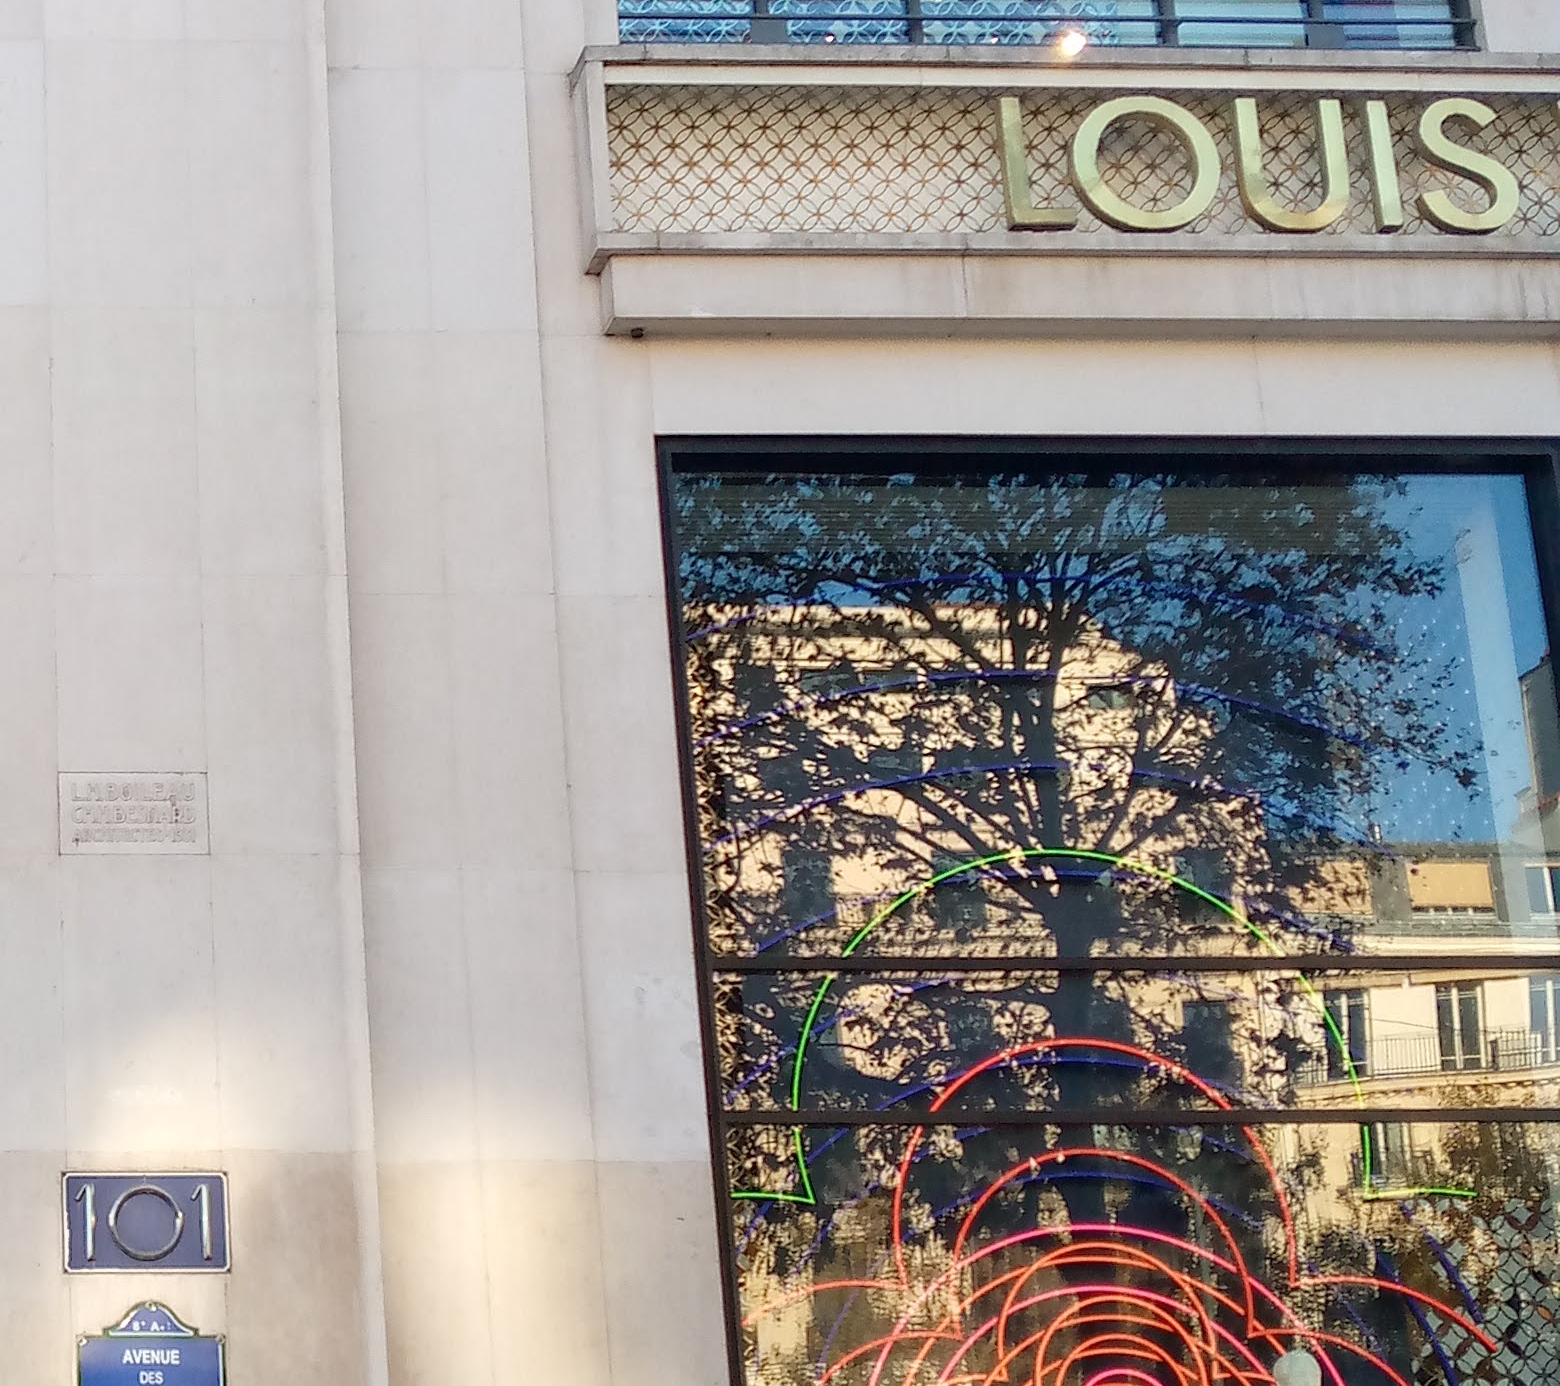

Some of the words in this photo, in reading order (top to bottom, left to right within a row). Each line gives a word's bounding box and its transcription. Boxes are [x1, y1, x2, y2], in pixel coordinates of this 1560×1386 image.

[998, 95, 1520, 233] LOUIS
[74, 1183, 213, 1262] 101
[122, 1349, 180, 1365] AVENUE
[139, 1371, 164, 1385] DES
